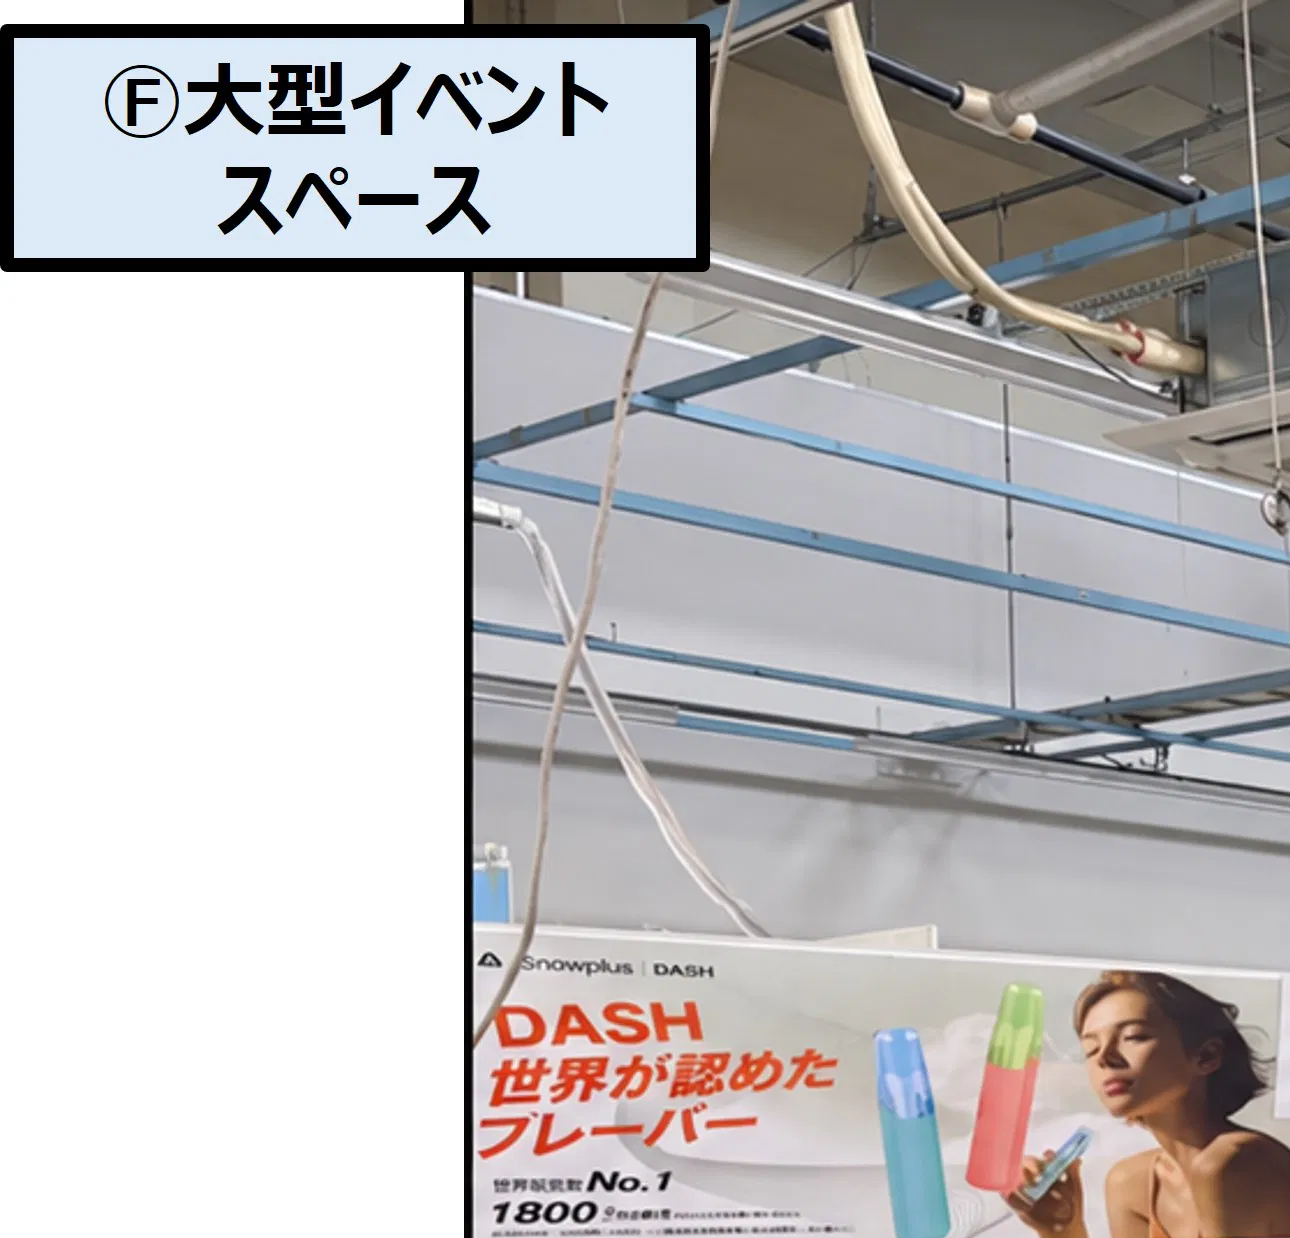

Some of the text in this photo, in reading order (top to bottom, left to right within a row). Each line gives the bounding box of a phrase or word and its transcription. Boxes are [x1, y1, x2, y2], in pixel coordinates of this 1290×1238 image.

[520, 955, 715, 978] Snowplus DASH
[492, 1001, 704, 1048] DASH
[488, 1048, 838, 1107] 世界が認めた
[585, 1170, 673, 1193] No.1
[491, 1201, 600, 1225] 1800
